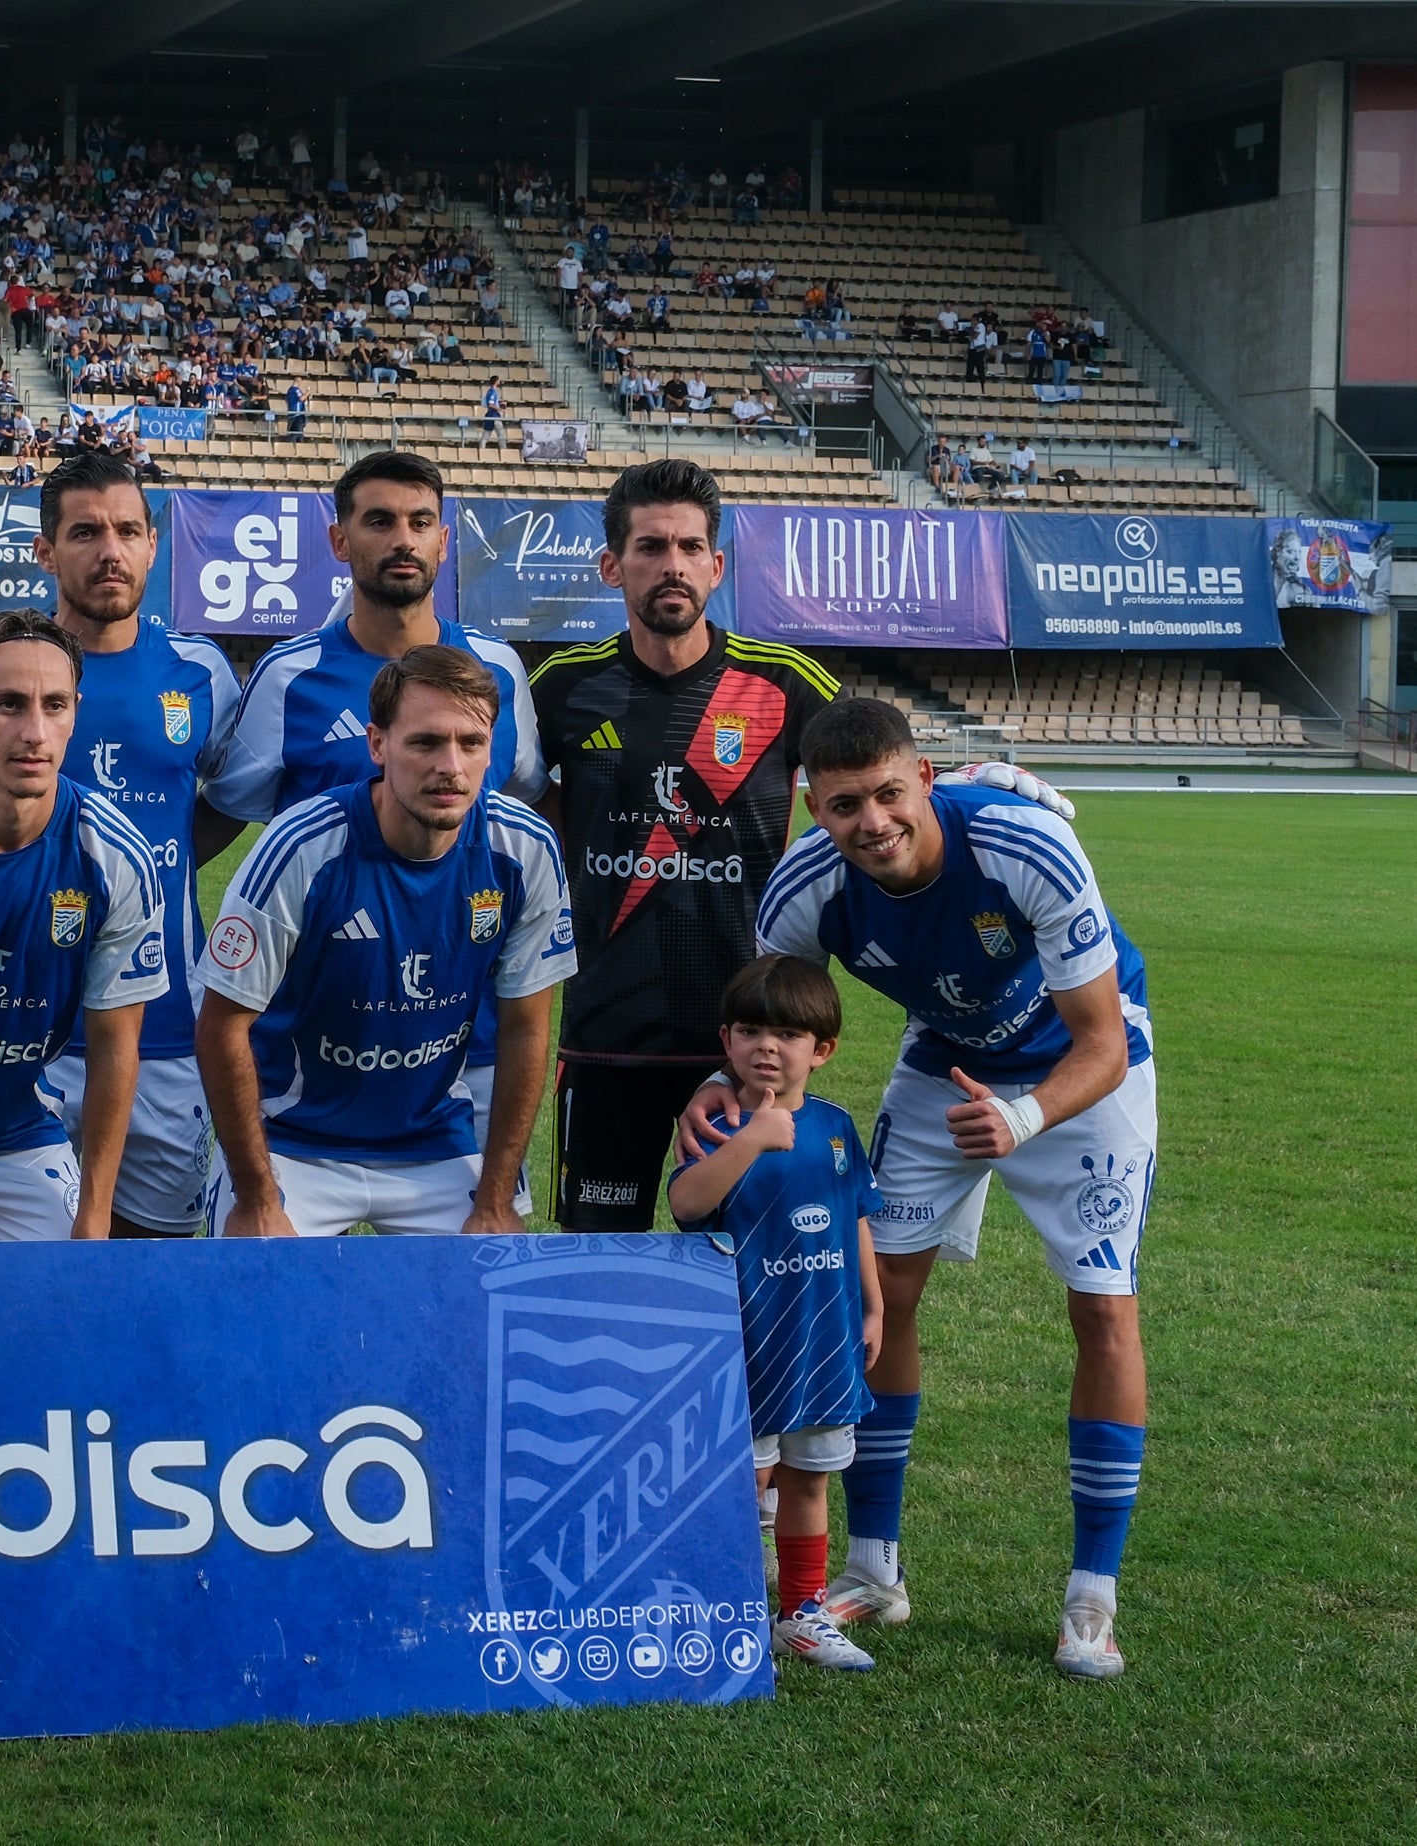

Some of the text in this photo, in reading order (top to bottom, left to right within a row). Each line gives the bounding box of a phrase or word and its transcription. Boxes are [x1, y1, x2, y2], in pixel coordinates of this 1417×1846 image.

[784, 516, 957, 600] KIRIBATI
[518, 573, 590, 582] EVENTOS
[1036, 559, 1243, 606] neopolis.es
[0, 579, 48, 598] 024
[1122, 595, 1185, 607] profesionales
[252, 609, 298, 625] center
[1045, 617, 1120, 635] 956058890
[1129, 618, 1243, 637] info@neopolis.es
[609, 811, 732, 828] LAFLAMENCA
[352, 991, 468, 1012] LAFLAMENCA
[579, 1183, 638, 1201] JEREZ 2031
[794, 1214, 829, 1228] LUGO
[907, 1206, 935, 1220] 2031
[467, 1600, 768, 1634] XEREZCLUBDEPORTIVO.ES
